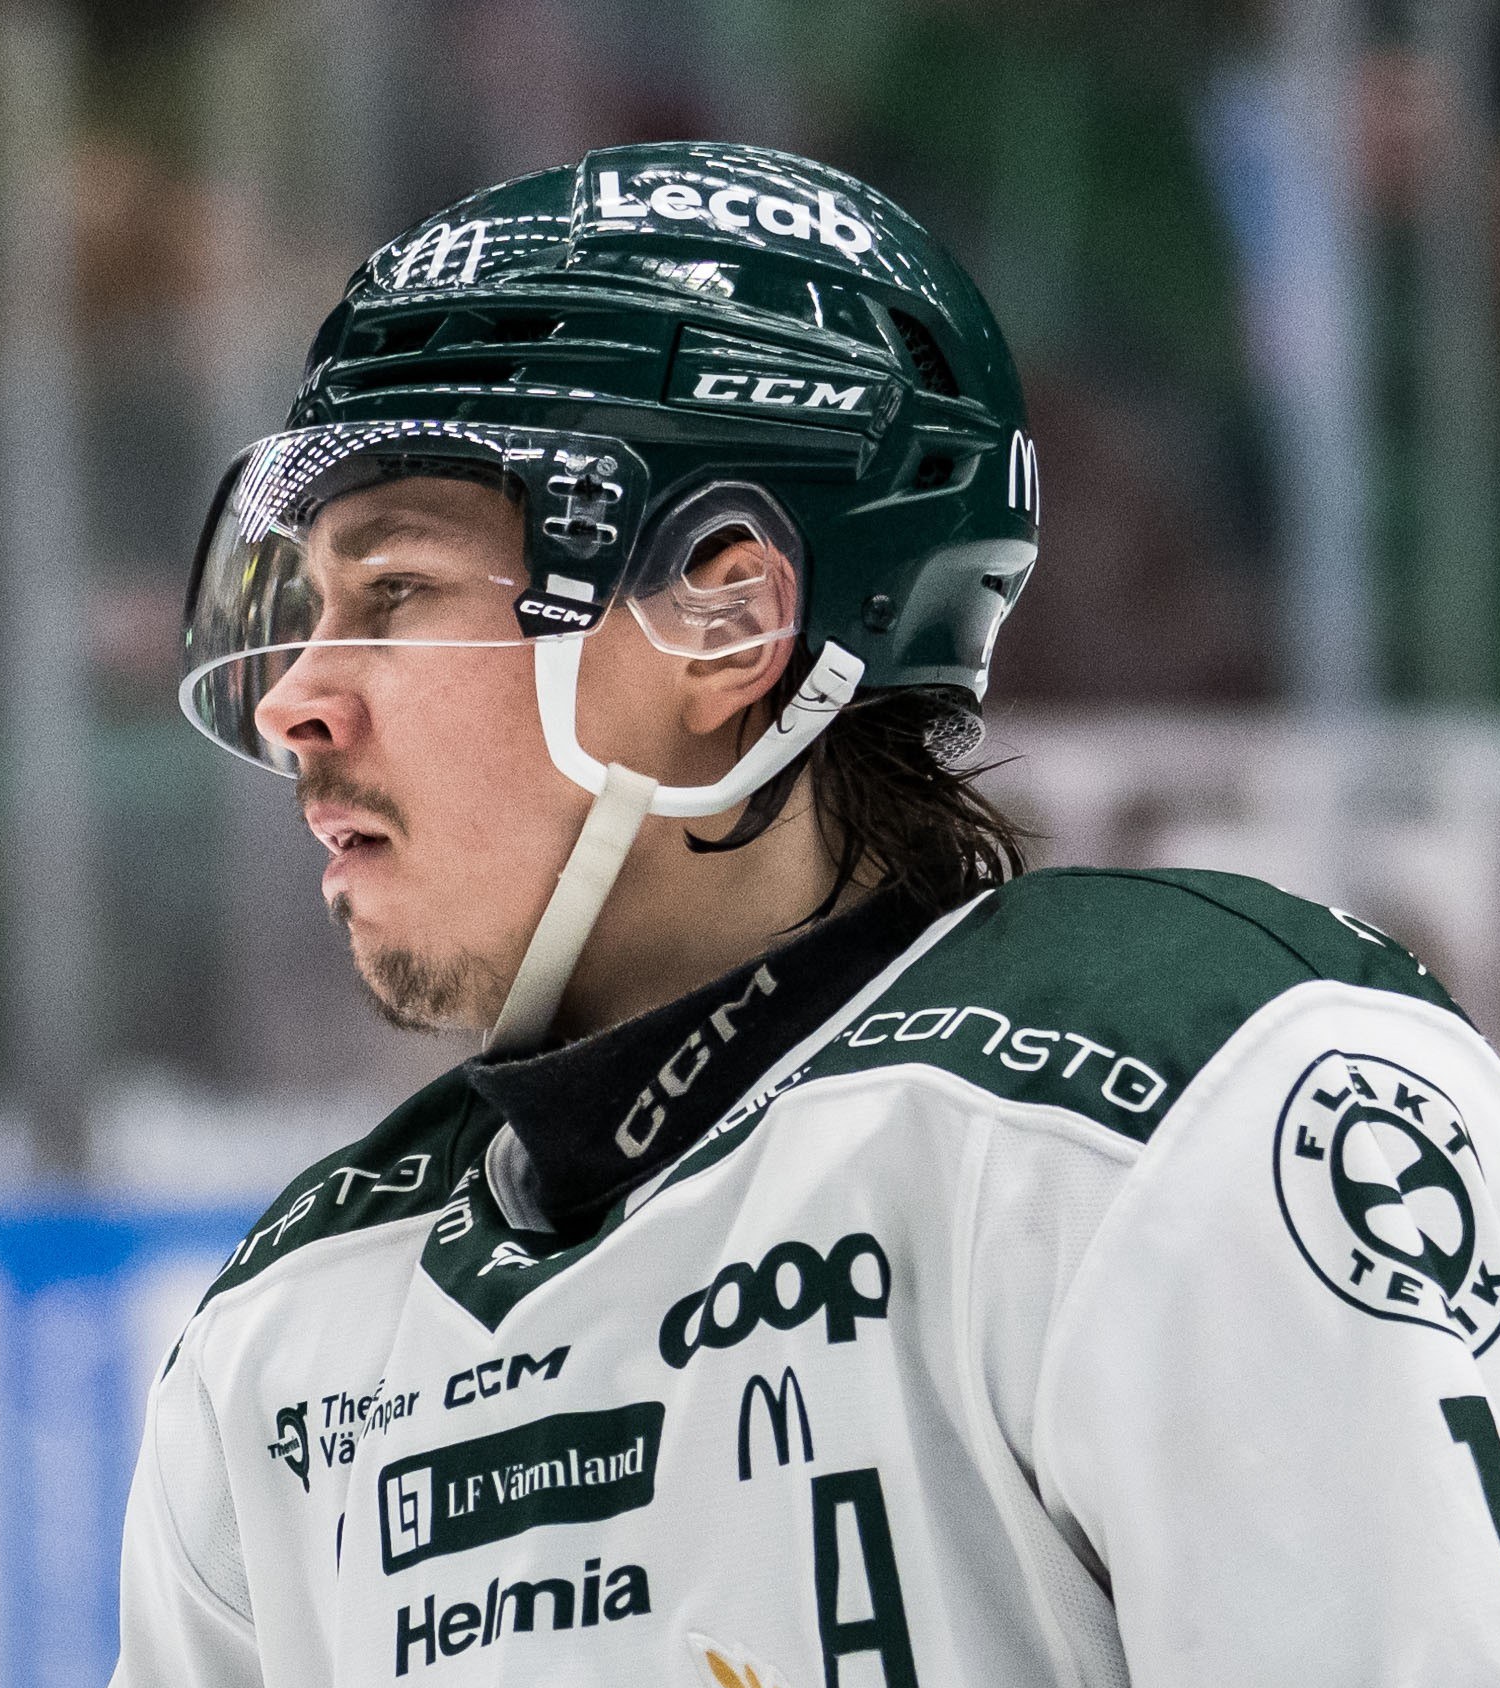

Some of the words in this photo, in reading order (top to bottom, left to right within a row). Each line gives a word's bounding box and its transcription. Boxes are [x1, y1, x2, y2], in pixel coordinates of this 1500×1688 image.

[599, 171, 872, 253] Lecab
[693, 373, 866, 411] CCM
[520, 600, 592, 626] CCM
[615, 963, 778, 1158] CCM
[659, 1230, 890, 1368] coop
[443, 1344, 572, 1410] CCM
[447, 1474, 484, 1518] LF
[491, 1436, 646, 1505] Värmland
[395, 1556, 652, 1678] Helmia
